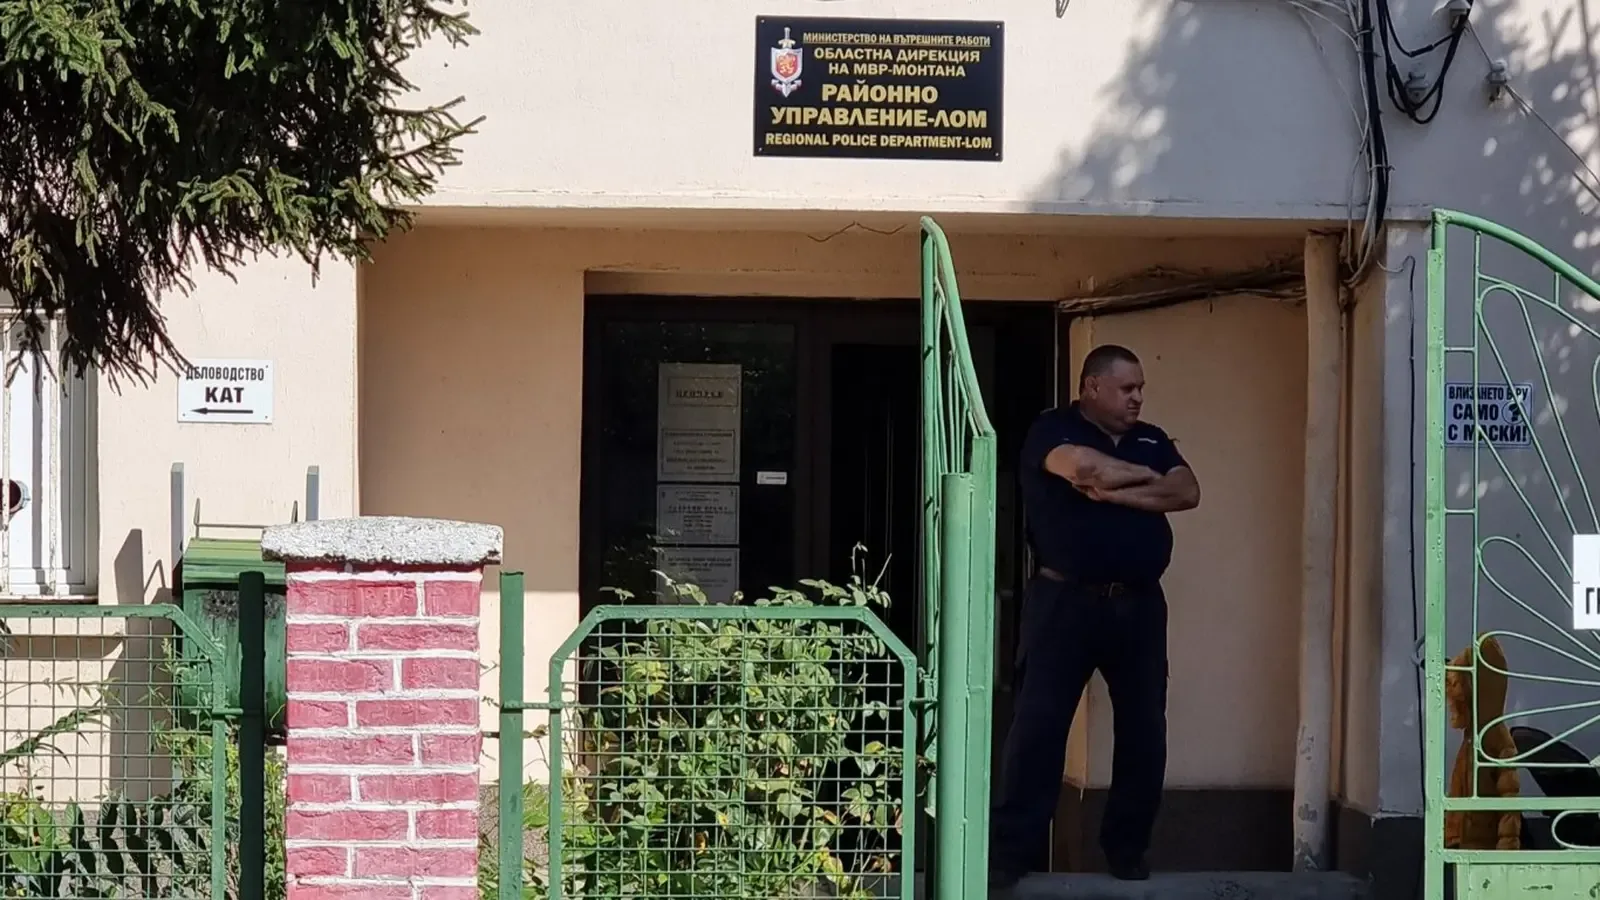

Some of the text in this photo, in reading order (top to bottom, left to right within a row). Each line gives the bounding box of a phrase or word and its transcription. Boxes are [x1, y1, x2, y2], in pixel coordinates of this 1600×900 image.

[803, 32, 991, 46] МИНИСТЕРСТВО НА ВЪТРЕШНИТЕ РАБОТИ
[814, 47, 980, 64] ОБЛАСТНА ДИРЕКЦИЯ
[828, 63, 966, 77] НА МВР-МОНТАНА
[822, 79, 938, 104] РАЙОННО
[771, 106, 987, 128] УПРАВЛЕНИЕ-ЛОМ
[765, 133, 992, 149] REGIONAL POLICE DEPARTMENT-LOM
[205, 386, 244, 403] КАТ
[1448, 424, 1458, 441] С
